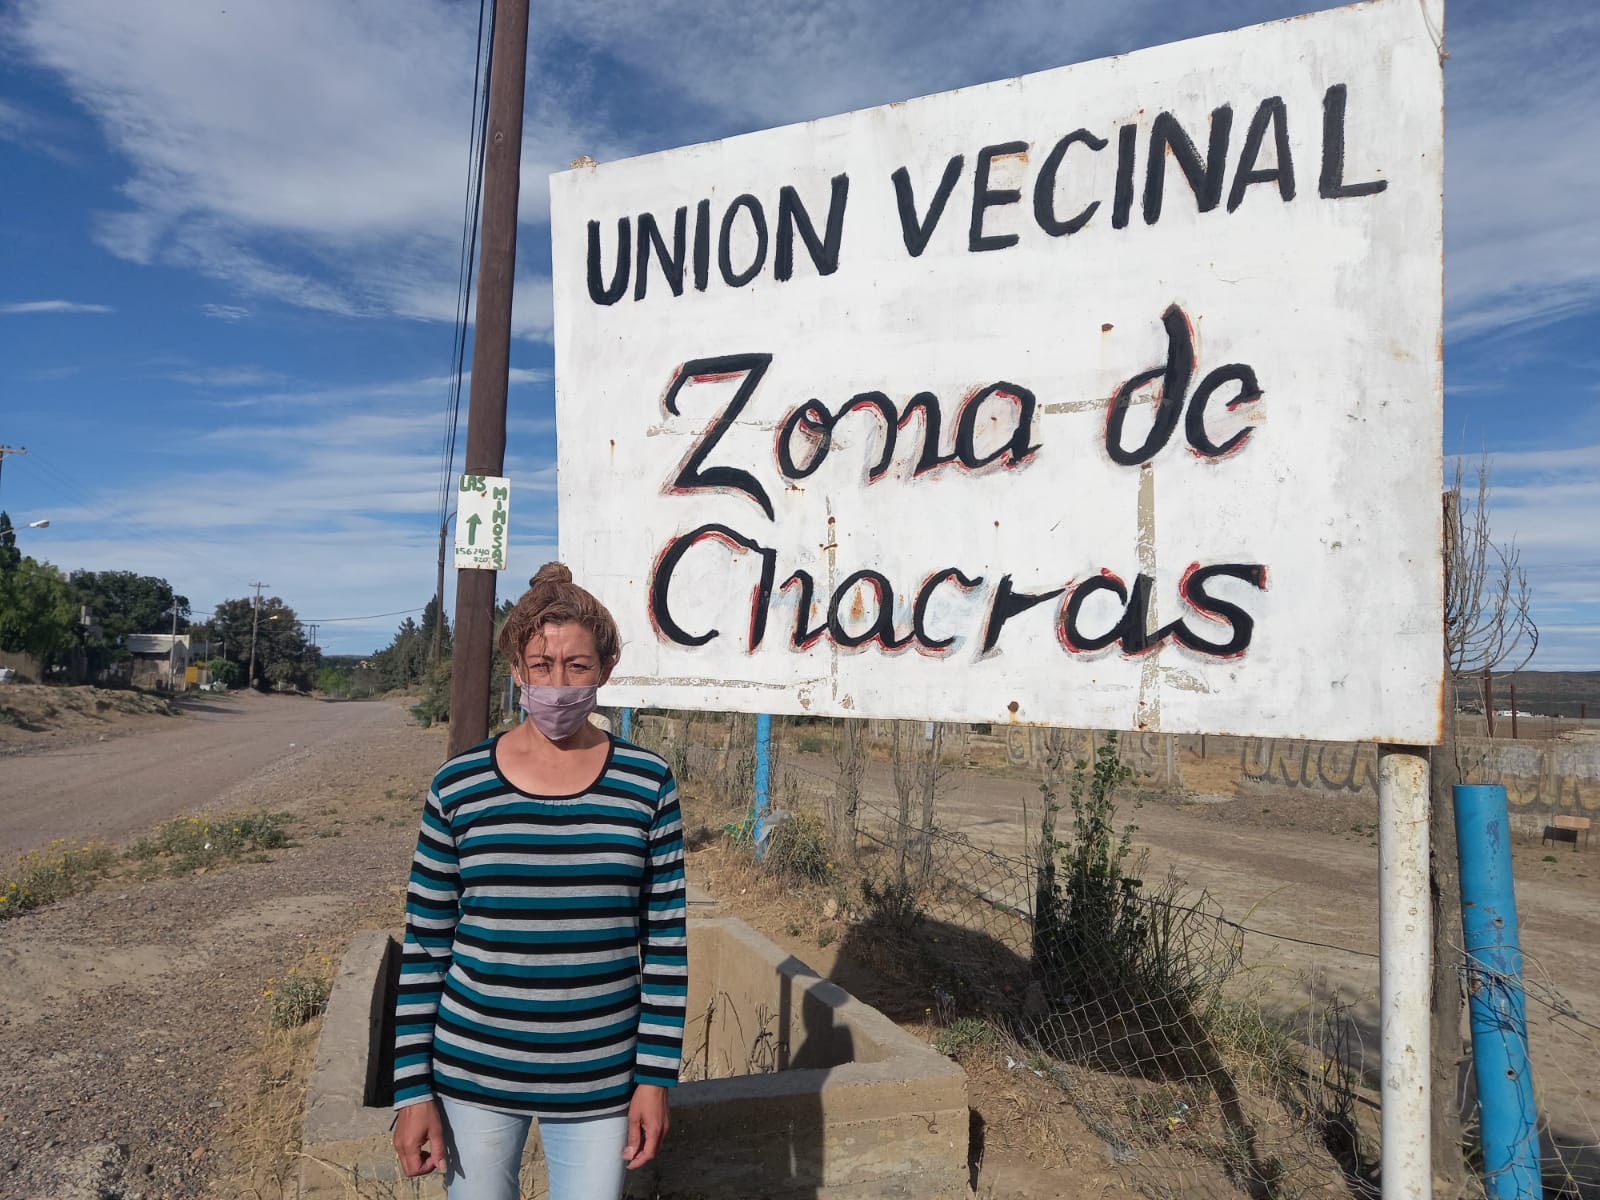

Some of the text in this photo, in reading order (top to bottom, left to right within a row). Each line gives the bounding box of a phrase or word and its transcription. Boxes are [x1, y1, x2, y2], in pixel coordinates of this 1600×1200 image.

[587, 84, 1388, 305] UNION VECINAL
[460, 475, 486, 491] LAS
[660, 303, 1264, 522] Zona de
[648, 523, 1268, 658] Chacras
